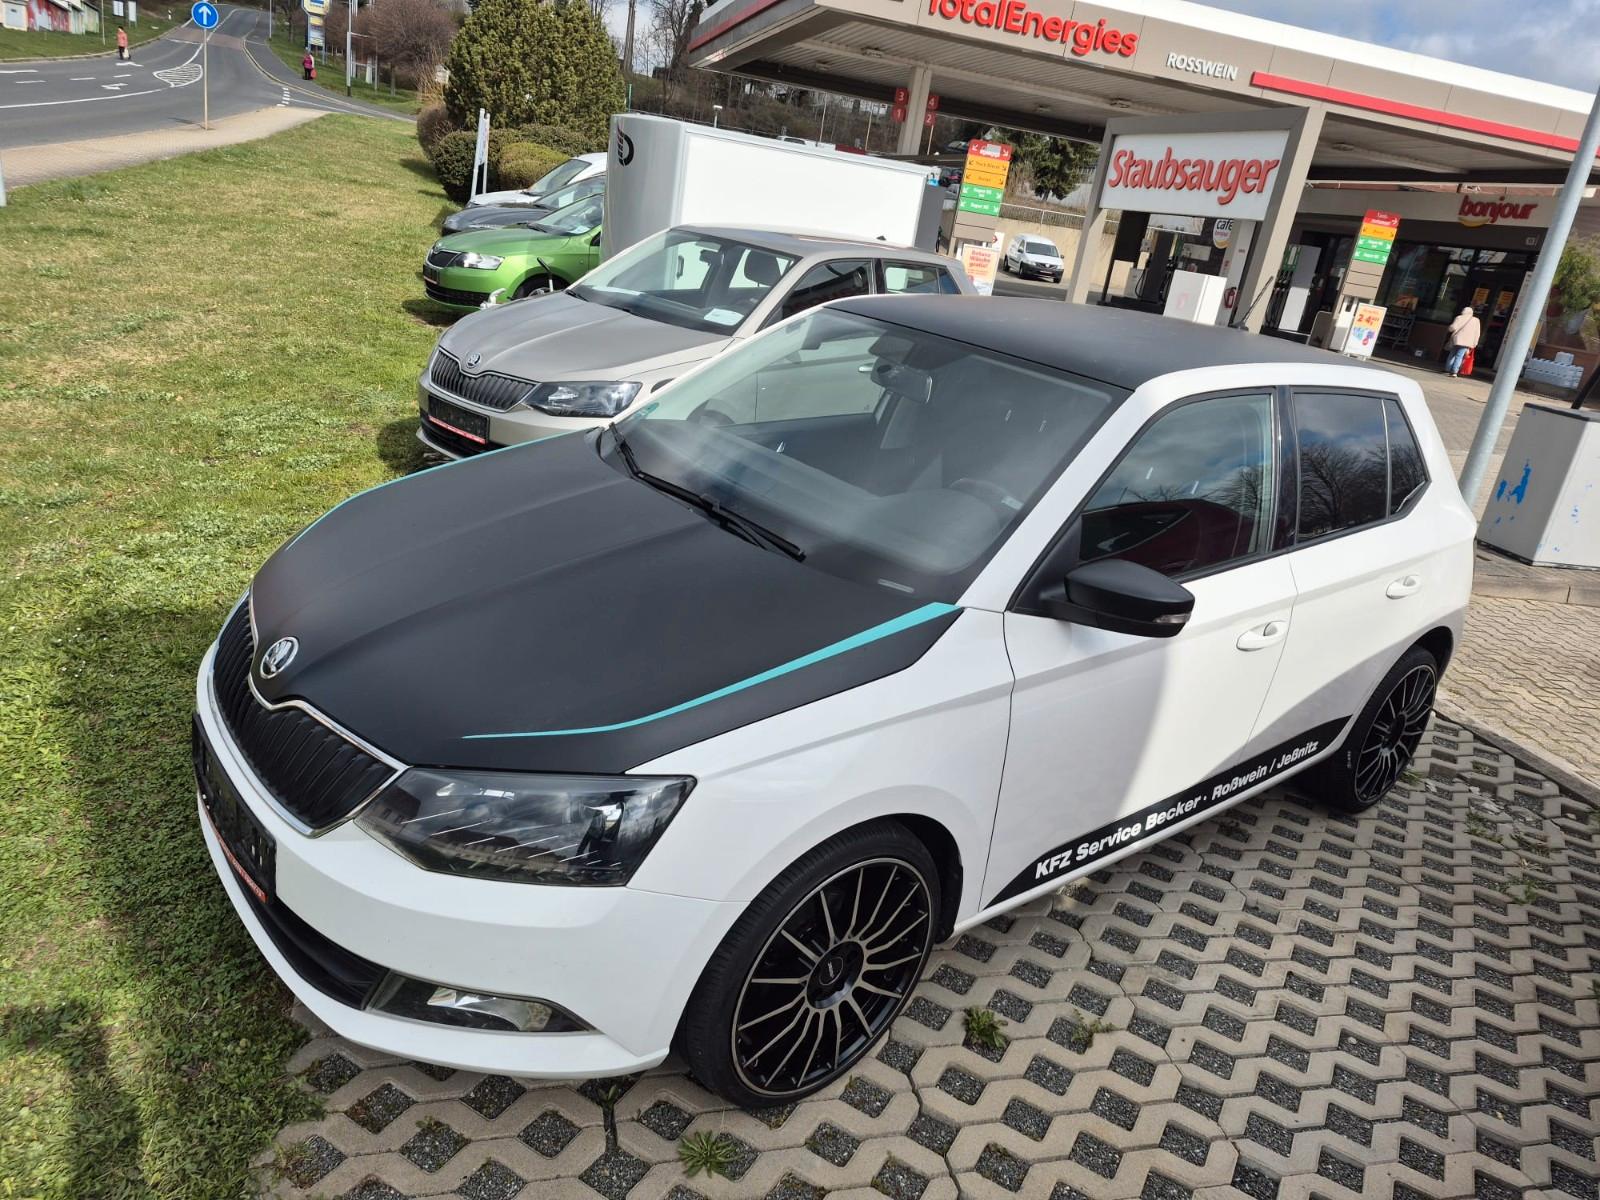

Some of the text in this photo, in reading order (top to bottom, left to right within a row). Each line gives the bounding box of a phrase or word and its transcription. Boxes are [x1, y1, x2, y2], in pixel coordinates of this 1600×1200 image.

[1166, 52, 1239, 81] ROSSWEIN
[898, 91, 905, 101] 3
[1108, 146, 1280, 206] Staubsauger
[1458, 195, 1538, 223] bonjour
[1035, 850, 1073, 879] KFZ
[1075, 822, 1141, 861] Service
[1145, 797, 1201, 831] Becker
[1212, 766, 1267, 800] Roßwein
[1277, 740, 1319, 769] Jeßnitz
